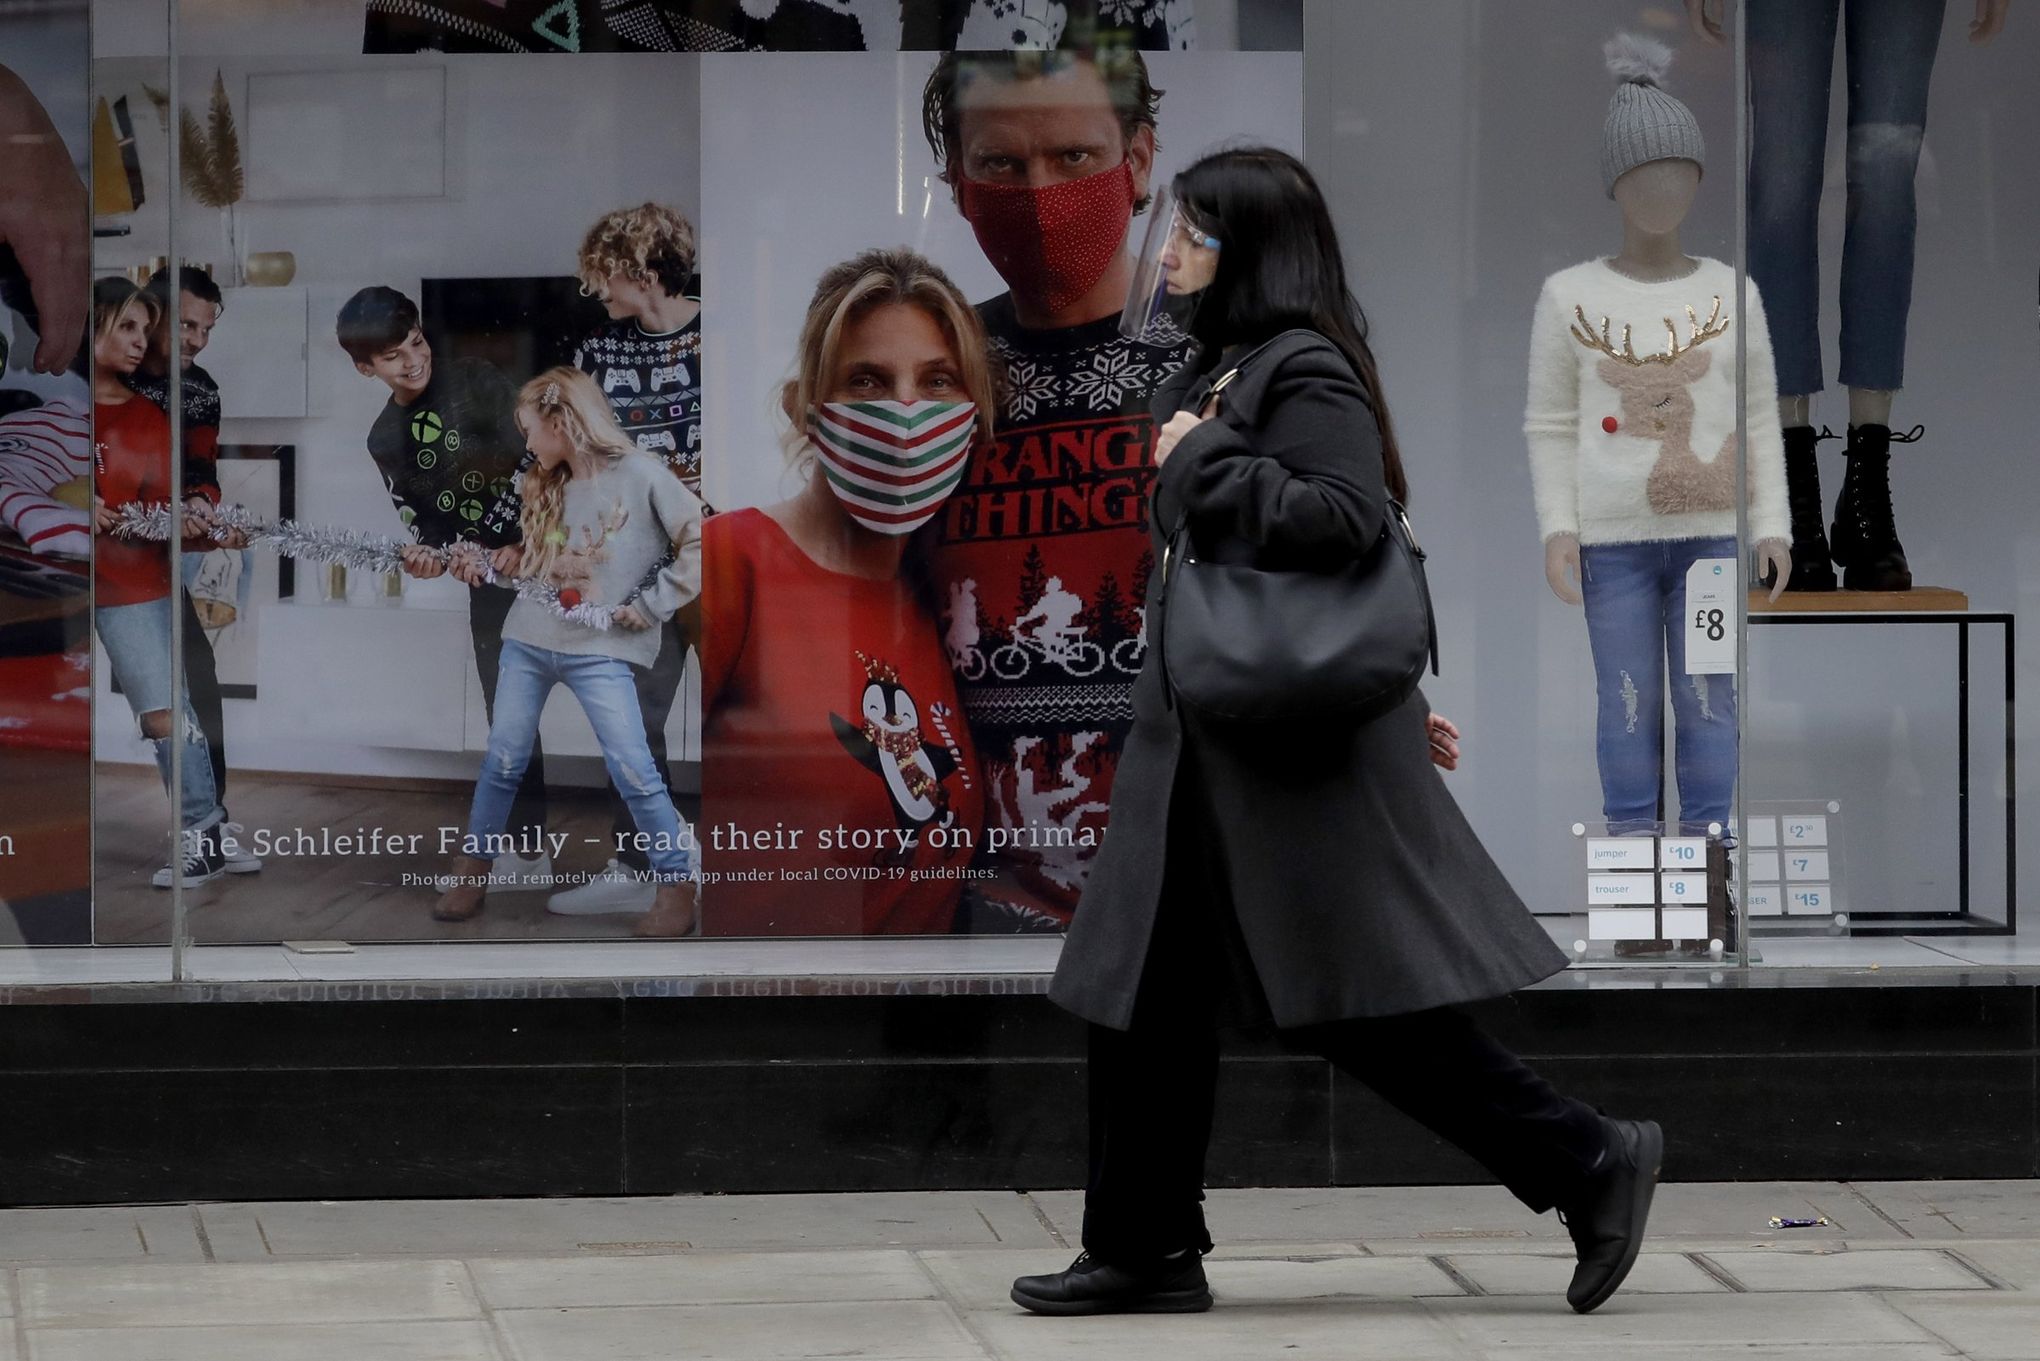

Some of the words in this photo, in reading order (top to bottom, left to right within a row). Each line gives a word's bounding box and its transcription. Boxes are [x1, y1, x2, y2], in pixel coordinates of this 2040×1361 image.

[1695, 608, 1725, 641] £8
[252, 827, 423, 856] Schleifer
[437, 825, 570, 859] Family
[615, 823, 700, 852] read
[710, 822, 804, 851] their
[817, 823, 915, 855] story
[928, 826, 974, 849] on
[1593, 848, 1629, 859] jumper
[1669, 846, 1695, 860] £10
[401, 872, 518, 887] Photographed
[523, 870, 597, 886] remotely
[603, 871, 628, 883] via
[633, 870, 721, 885] WhatsApp
[726, 868, 775, 882] under
[780, 867, 819, 881] local
[823, 867, 905, 881] COVID-19
[910, 866, 999, 882] guidelines.
[1595, 885, 1630, 894] trouser
[1669, 881, 1686, 895] £8
[1794, 893, 1820, 906] £15
